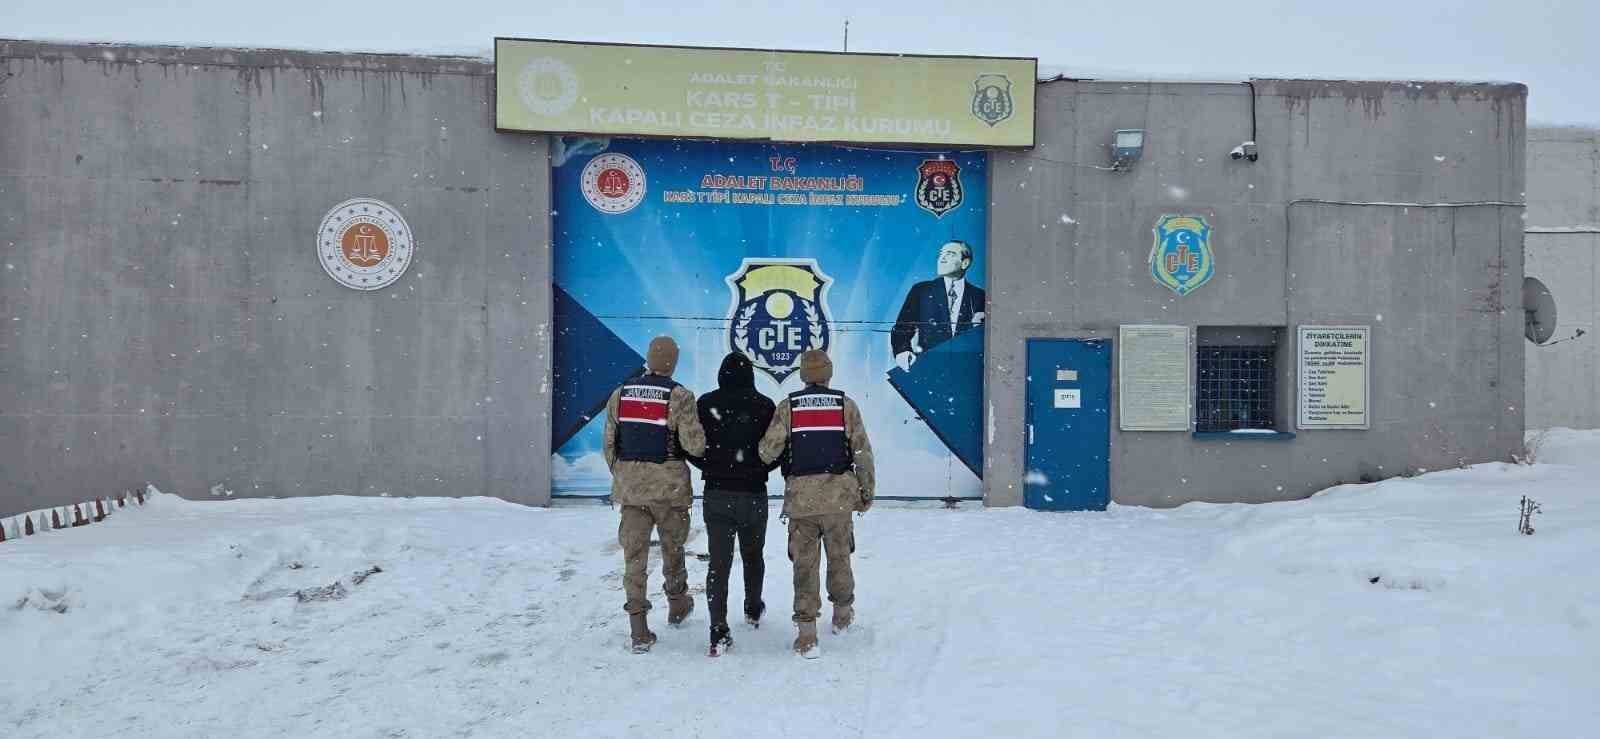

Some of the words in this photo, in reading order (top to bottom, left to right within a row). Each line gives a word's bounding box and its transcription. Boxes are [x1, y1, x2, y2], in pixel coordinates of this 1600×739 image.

[688, 72, 757, 84] ADALET
[687, 91, 756, 108] KARS
[765, 93, 783, 110] T
[808, 91, 857, 111] TİPİ
[984, 100, 1002, 113] CTE
[590, 107, 680, 127] KAPALI
[688, 111, 755, 129] CEZA
[844, 115, 951, 136] KURUMU
[701, 174, 767, 188] ADALET
[771, 175, 864, 191] BAKANLIĞI
[663, 190, 696, 203] KARS
[929, 186, 951, 202] CTE
[1165, 245, 1200, 273] CTE
[758, 319, 802, 350] CTE
[772, 352, 790, 361] 1923
[624, 387, 664, 400] JANDARMA
[798, 396, 838, 408] JANDARMA
